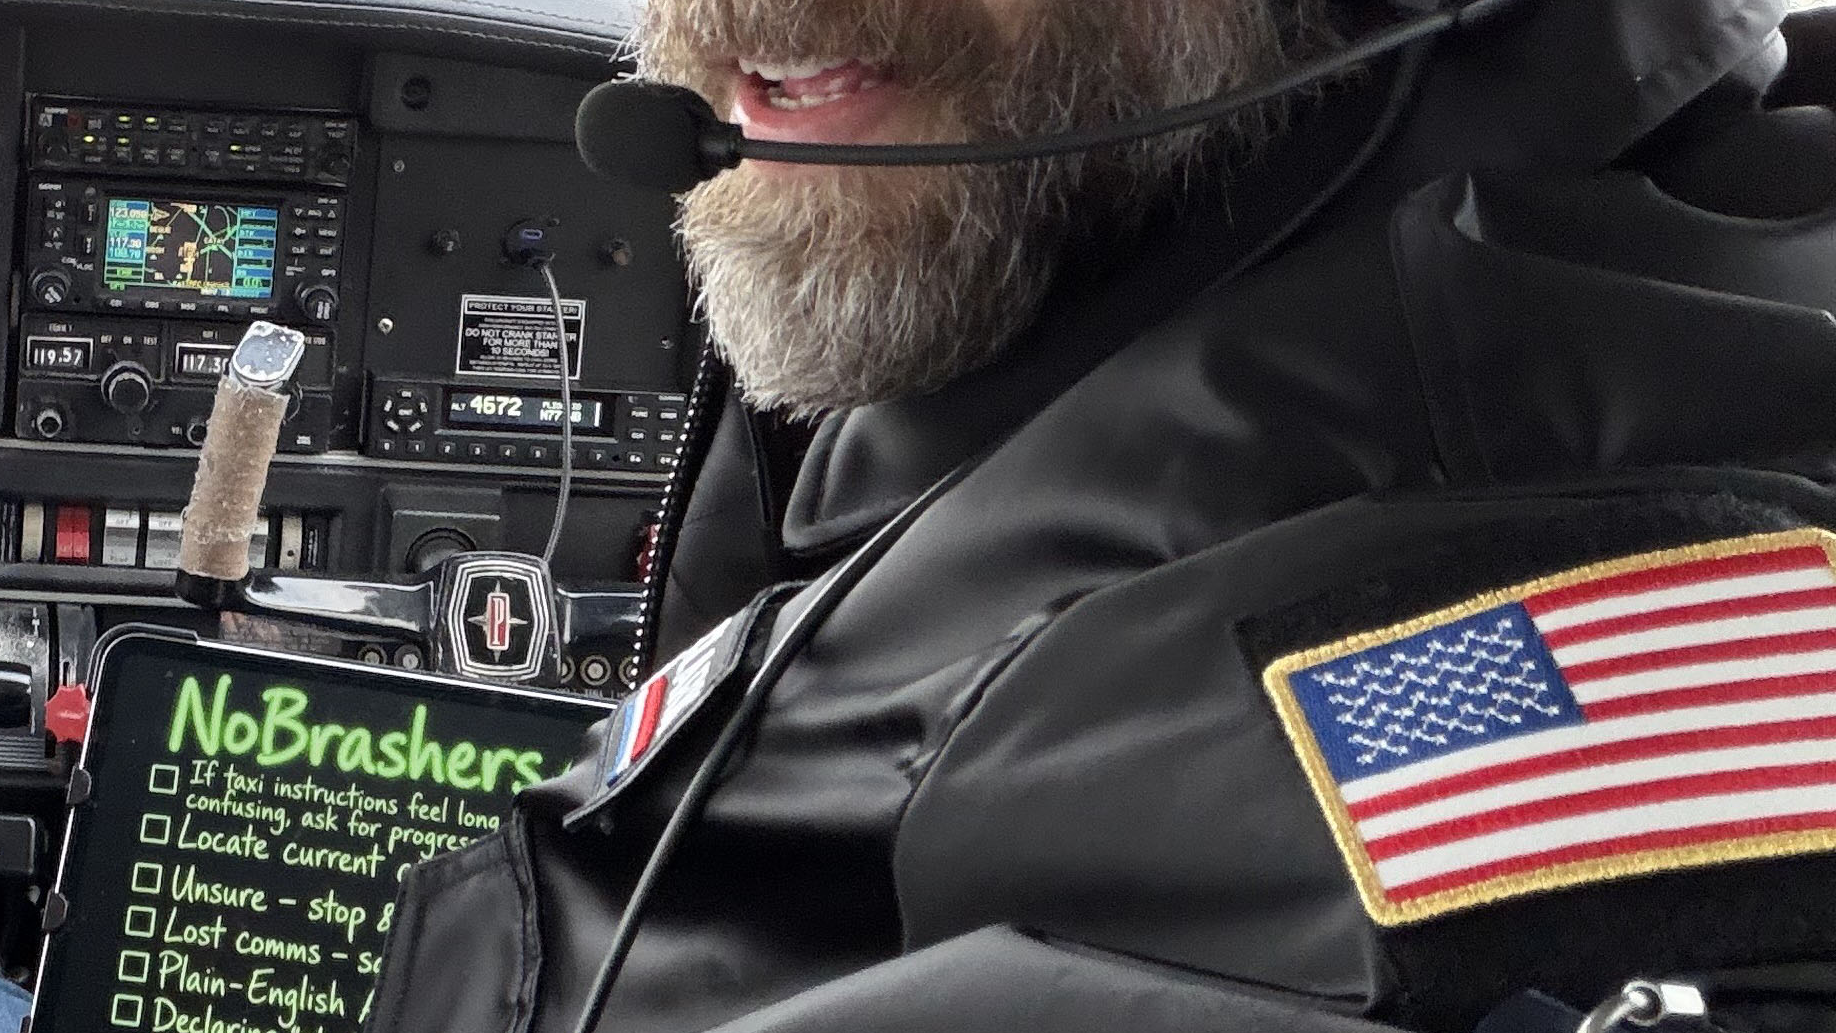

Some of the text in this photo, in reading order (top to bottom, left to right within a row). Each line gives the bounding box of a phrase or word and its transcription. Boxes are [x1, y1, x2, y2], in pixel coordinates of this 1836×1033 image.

[34, 347, 83, 366] 119.57
[481, 329, 500, 338] NOT
[502, 331, 533, 340] CRANK
[483, 338, 558, 349] FOR MORE THAN
[470, 395, 523, 416] 4672
[168, 673, 545, 795] NoBrashers
[186, 789, 479, 860] confusing, ask for progres
[190, 759, 500, 833] If taxi instructions feel long
[178, 812, 270, 860] Locate
[282, 843, 385, 878] current
[164, 906, 227, 949] Lost
[235, 931, 321, 965] comms
[172, 864, 268, 912] Unsure
[307, 889, 366, 944] stop
[158, 949, 345, 1029] Plain-English
